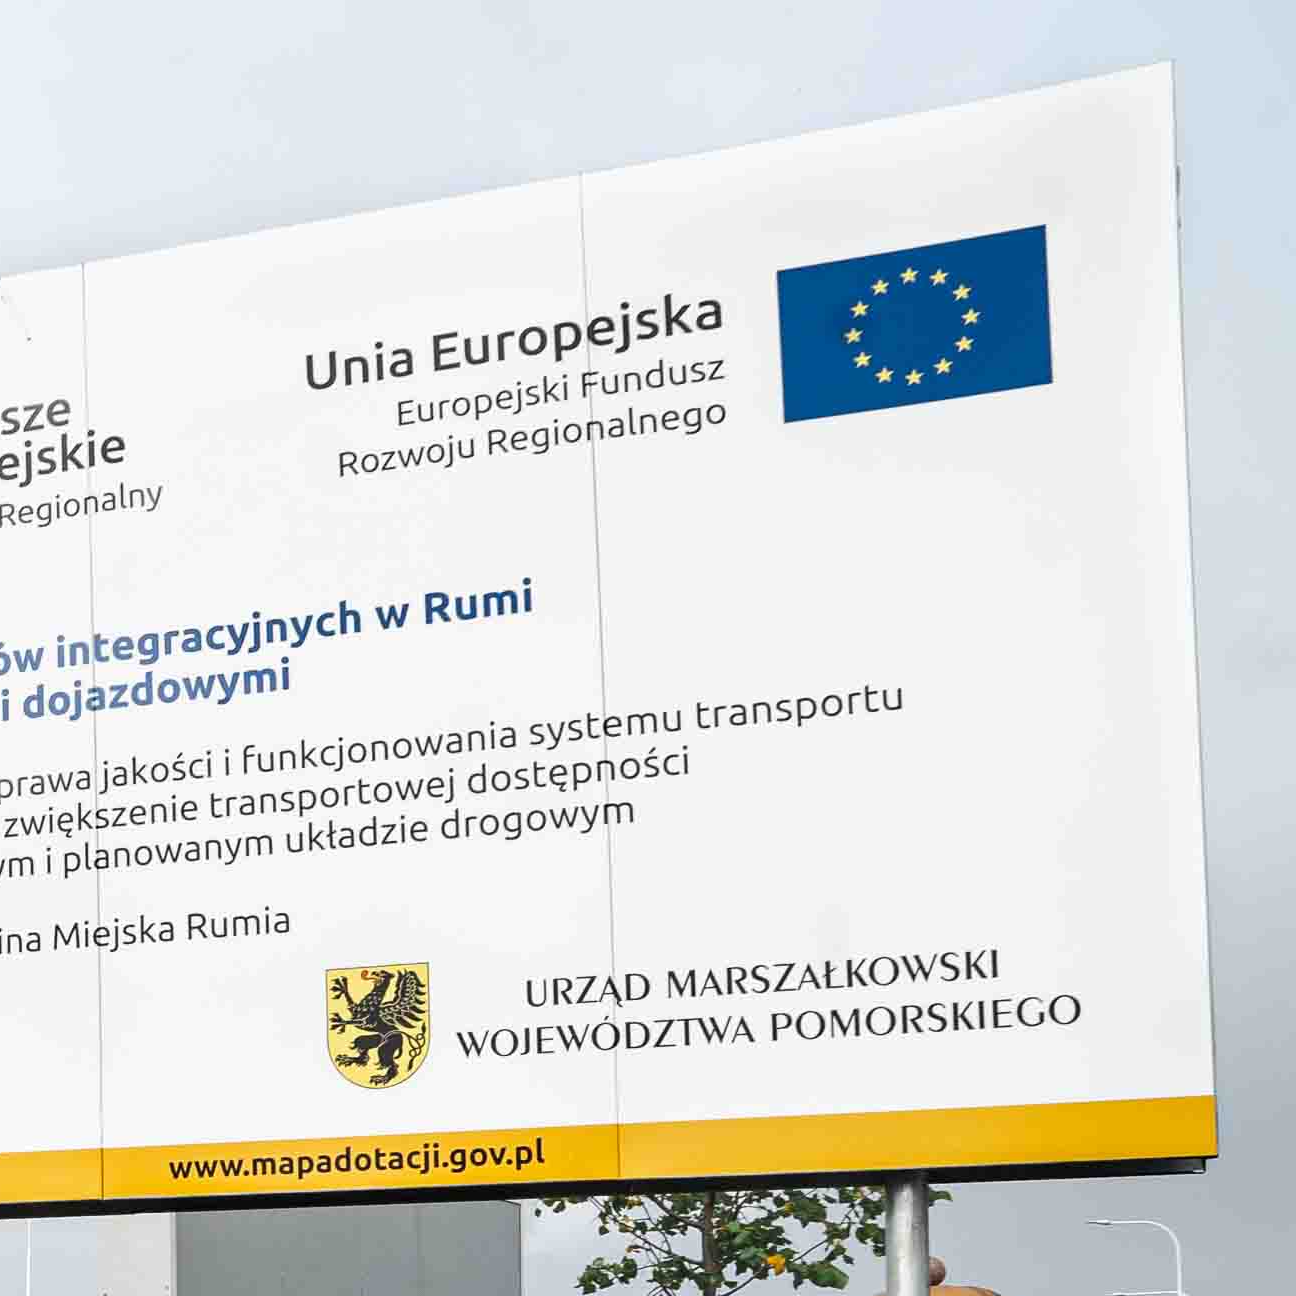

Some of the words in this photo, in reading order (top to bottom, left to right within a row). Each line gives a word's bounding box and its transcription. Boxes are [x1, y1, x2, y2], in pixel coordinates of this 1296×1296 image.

[306, 342, 413, 390] Unia
[433, 294, 722, 371] Europejska
[398, 374, 567, 426] Europejski
[582, 360, 725, 398] Fundusz
[339, 435, 474, 477] Rozwoju
[488, 404, 726, 455] Regionalnego
[0, 483, 162, 528] Regionalny
[57, 600, 361, 667] integracyjnych
[375, 603, 409, 630] w
[425, 577, 532, 624] Rumi
[24, 656, 289, 721] dojazdowymi
[99, 750, 211, 794] jakości
[225, 749, 229, 776] i
[243, 721, 516, 774] funkcjonowania
[530, 710, 681, 750] systemu
[697, 685, 902, 729] transportu
[4, 795, 198, 838] zwiększenie
[211, 768, 454, 818] transportowej
[468, 745, 688, 794] dostępności
[47, 848, 51, 874] i
[64, 835, 273, 879] planowanym
[286, 815, 428, 853] układzie
[441, 802, 633, 840] drogowym
[54, 915, 174, 952] Miejska
[188, 906, 289, 940] Rumia
[527, 973, 650, 1007] URZĄD
[668, 950, 998, 998] MARSZAŁKOWSKI
[457, 1016, 755, 1057] WOJEWÓDZTWA
[771, 995, 1081, 1041] POMORSKIEGO
[170, 1138, 544, 1179] www.mapadotacji.gov.pl
